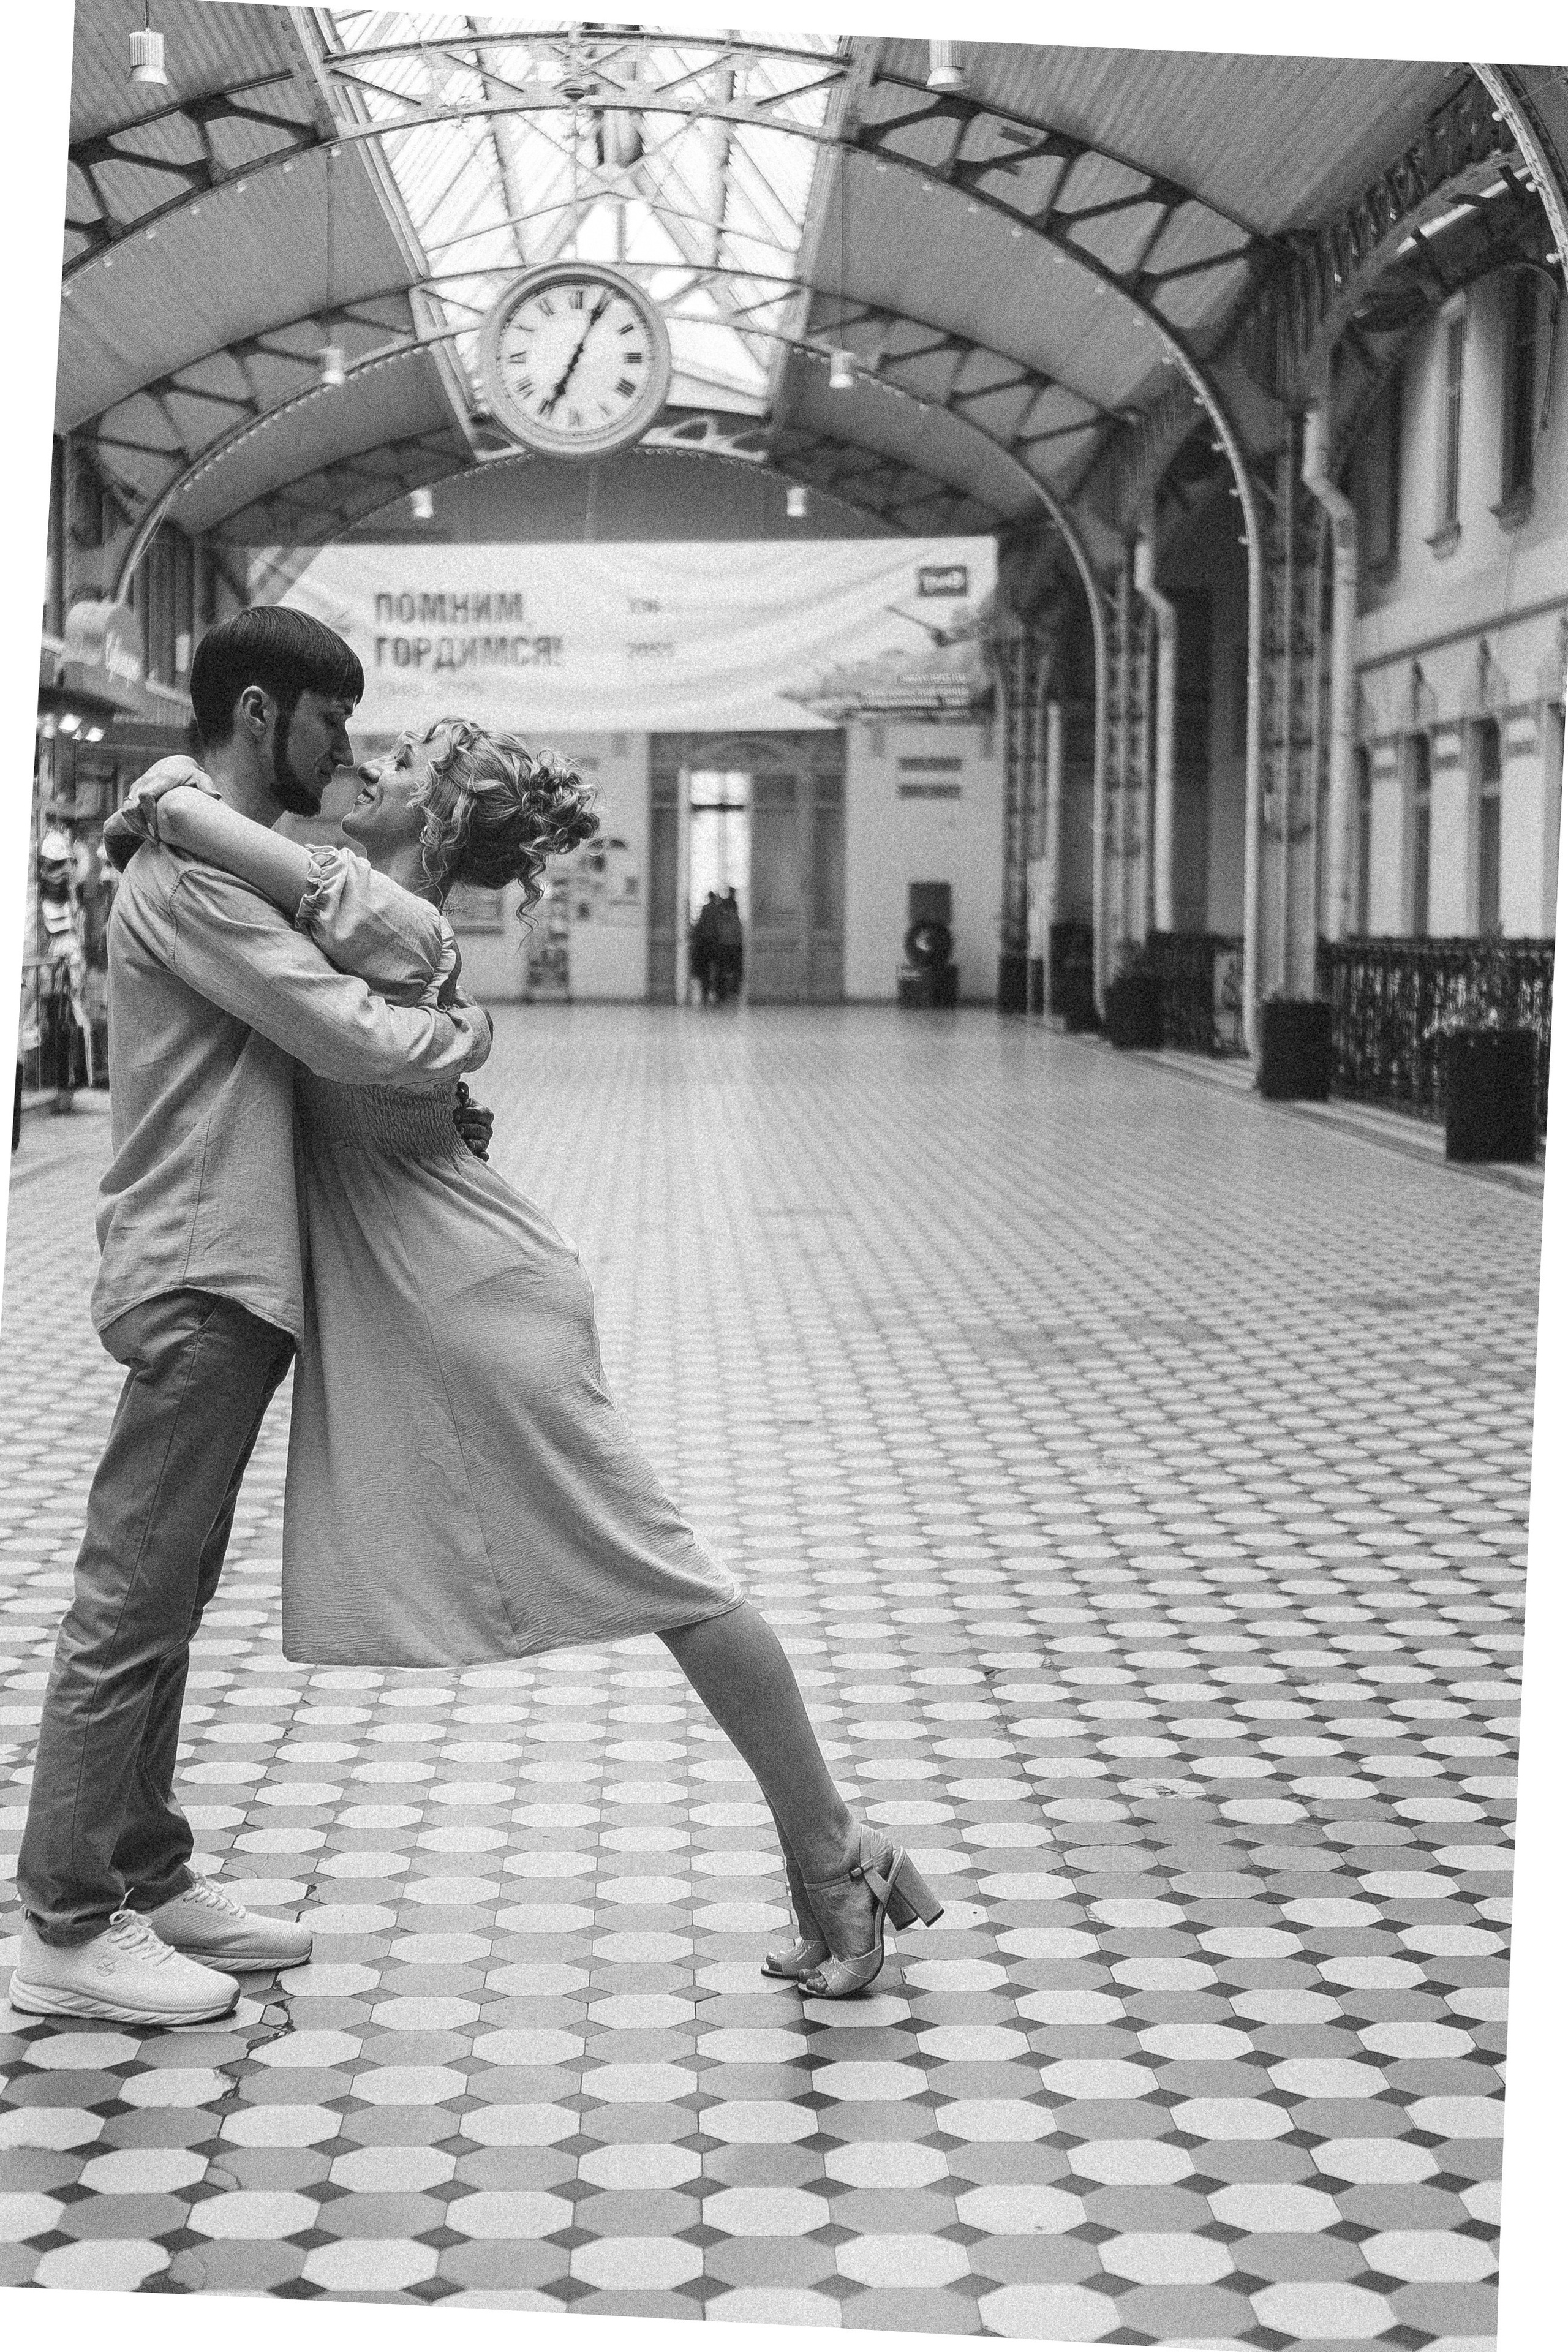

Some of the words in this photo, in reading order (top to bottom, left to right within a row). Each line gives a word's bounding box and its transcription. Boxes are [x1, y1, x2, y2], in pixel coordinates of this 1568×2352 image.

[617, 323, 634, 335] II
[624, 352, 643, 364] III
[374, 592, 523, 623] ПОМНИМ
[374, 636, 563, 672] ГОРДИМСЯ!
